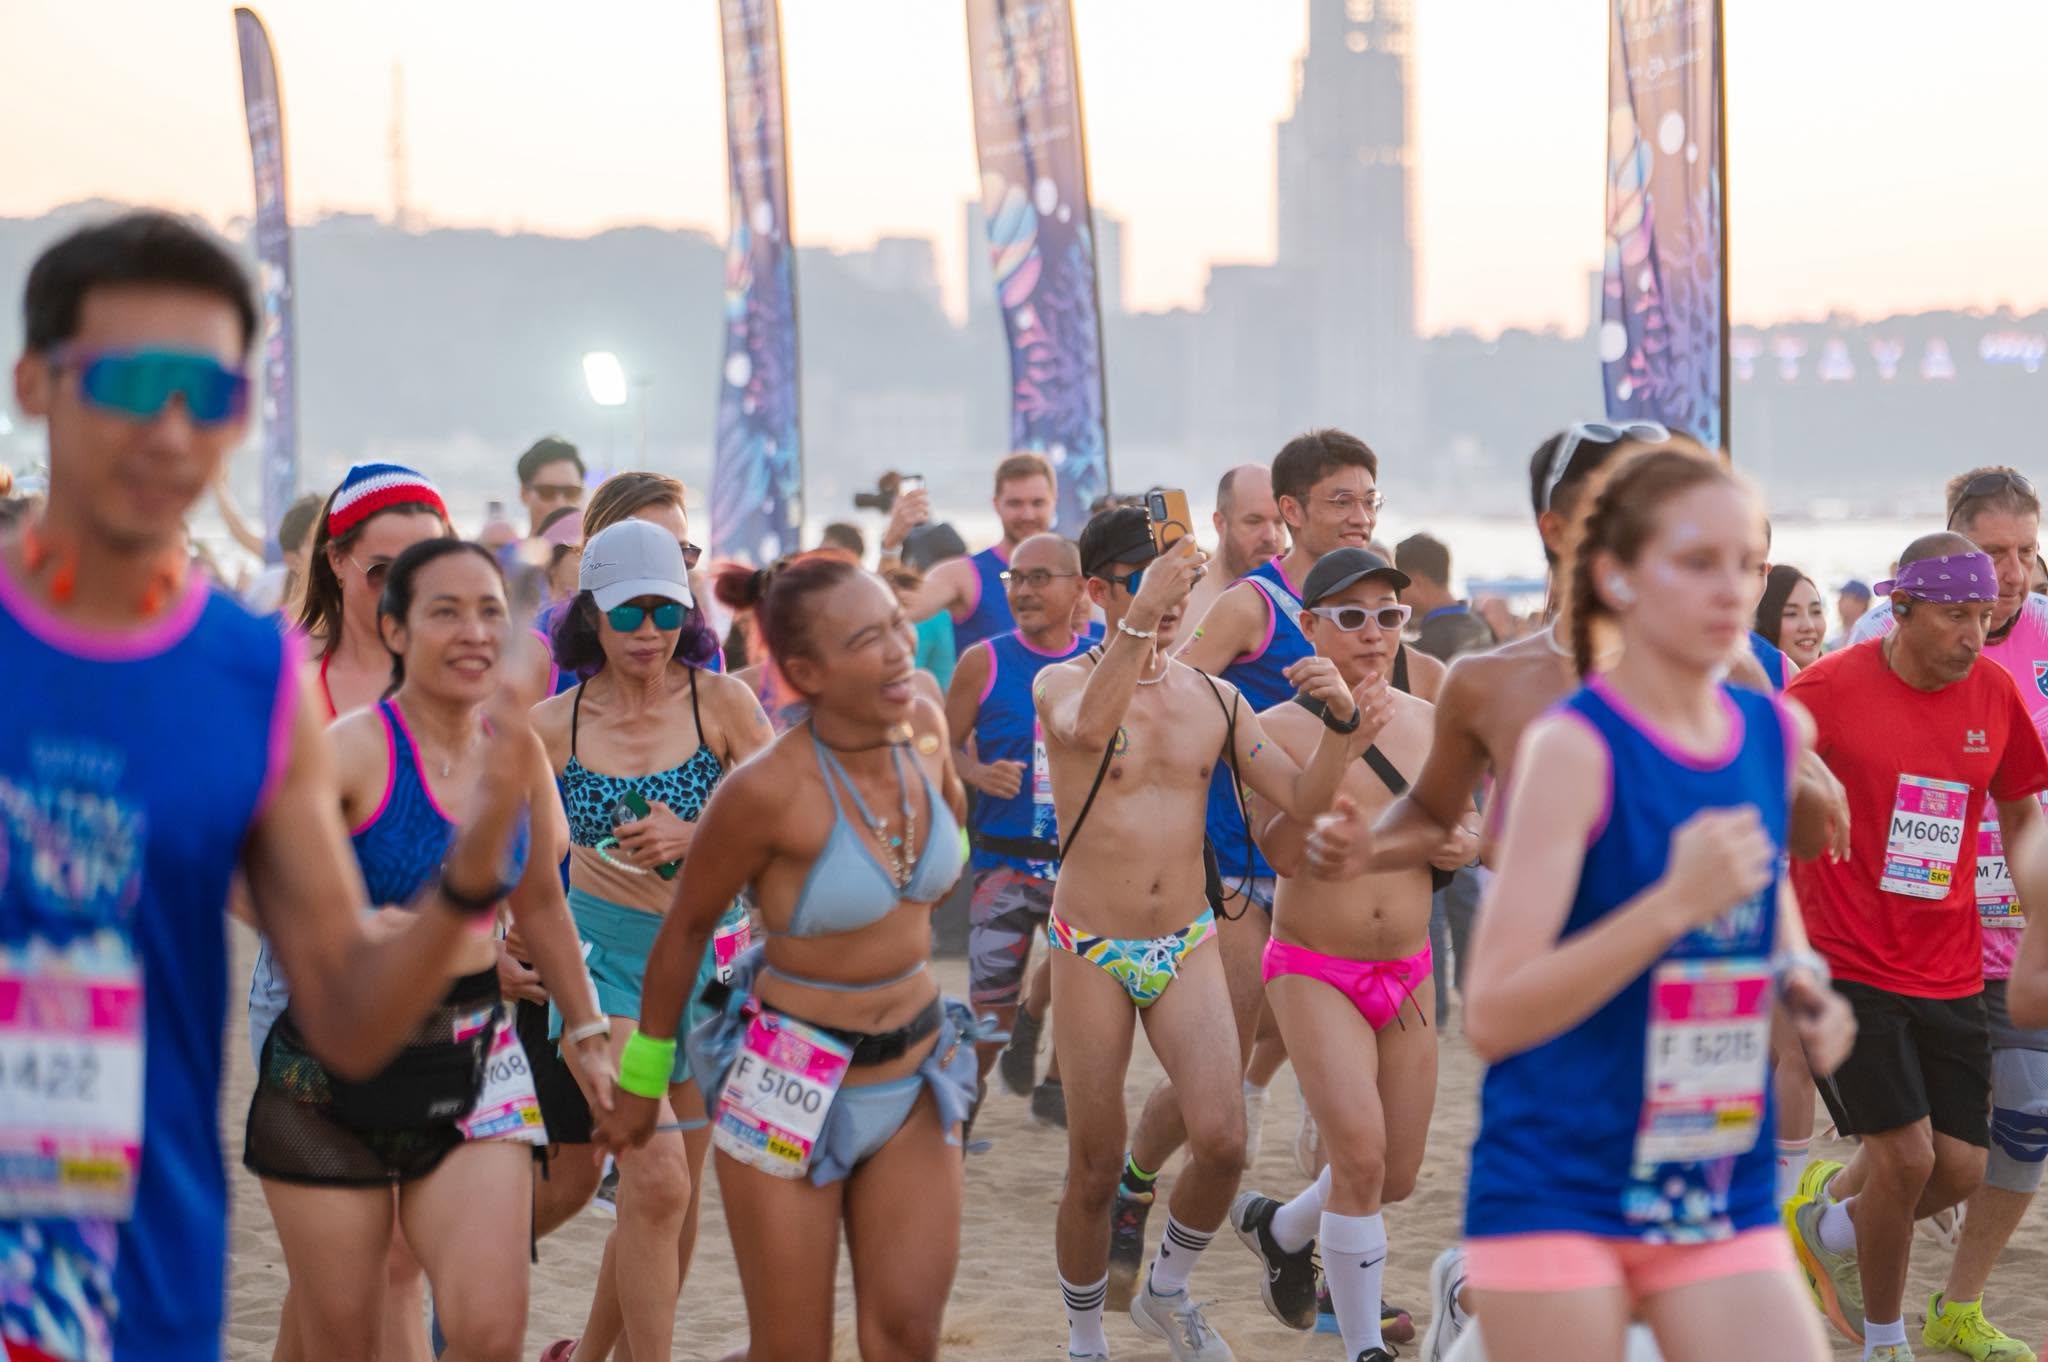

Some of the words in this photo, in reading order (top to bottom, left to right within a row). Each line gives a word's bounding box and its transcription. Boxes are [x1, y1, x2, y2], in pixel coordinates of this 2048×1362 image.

[1729, 334, 1956, 383] TTAYA
[1892, 817, 1960, 845] M6063
[1931, 872, 1950, 882] 5KM
[1993, 862, 2012, 880] 72
[0, 1050, 101, 1101] 422
[736, 1055, 755, 1079] F
[758, 1067, 822, 1114] 5100
